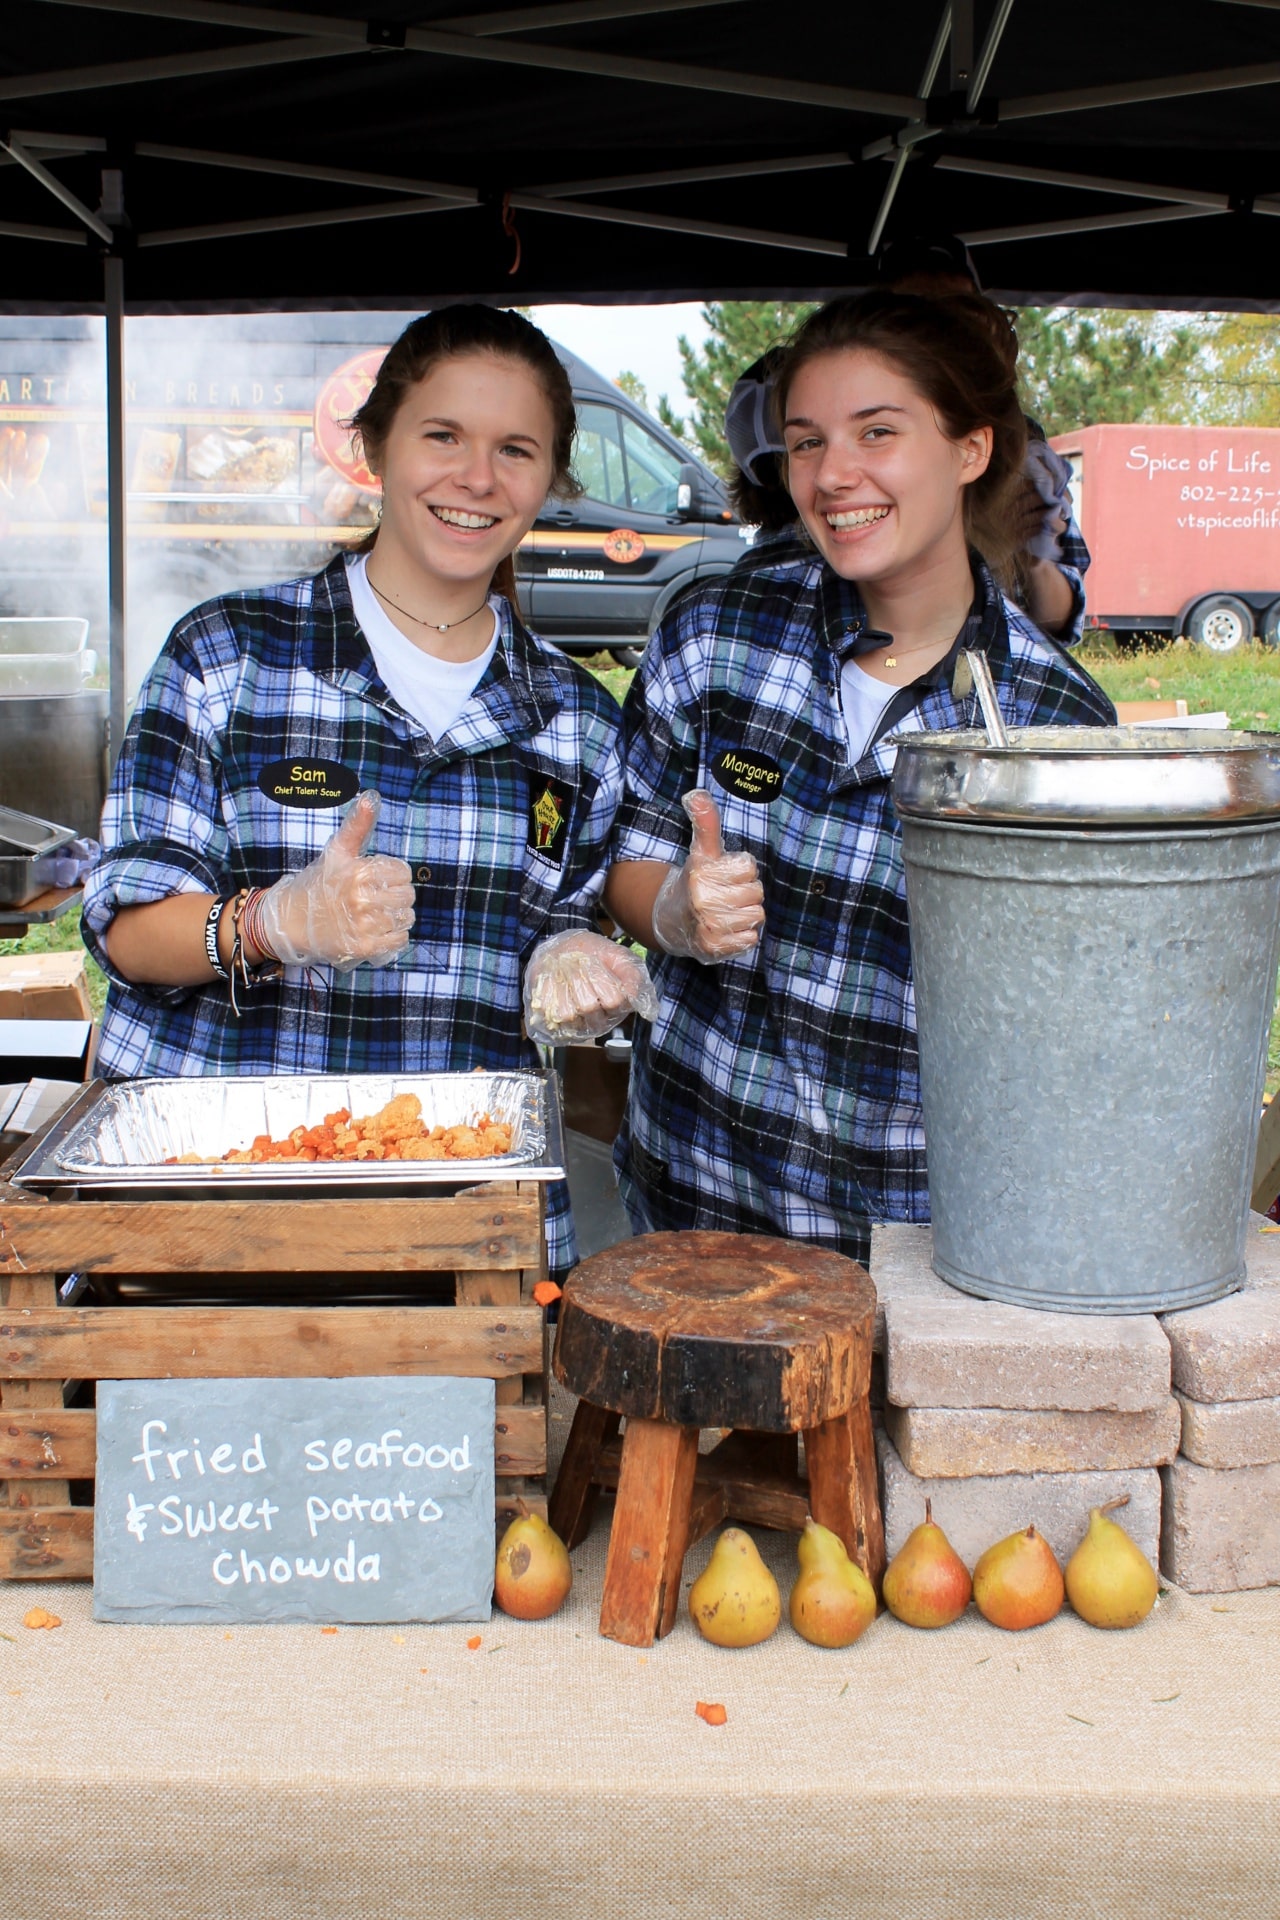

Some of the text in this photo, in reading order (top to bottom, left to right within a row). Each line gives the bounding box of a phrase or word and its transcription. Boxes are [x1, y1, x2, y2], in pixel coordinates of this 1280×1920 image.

[0, 377, 286, 406] ARTISN BREADS
[1125, 445, 1271, 480] Spice of Life
[1180, 485, 1280, 505] 802-225-
[1176, 507, 1280, 537] vtspiceoflif
[289, 765, 327, 783] Sam
[720, 752, 781, 785] Margaret
[273, 785, 342, 797] Chief Talent Scout
[734, 777, 762, 793] Avenger
[209, 902, 224, 920] TO
[205, 922, 220, 964] WRITE
[132, 1419, 473, 1482] fried seafood
[306, 1491, 444, 1538] potato
